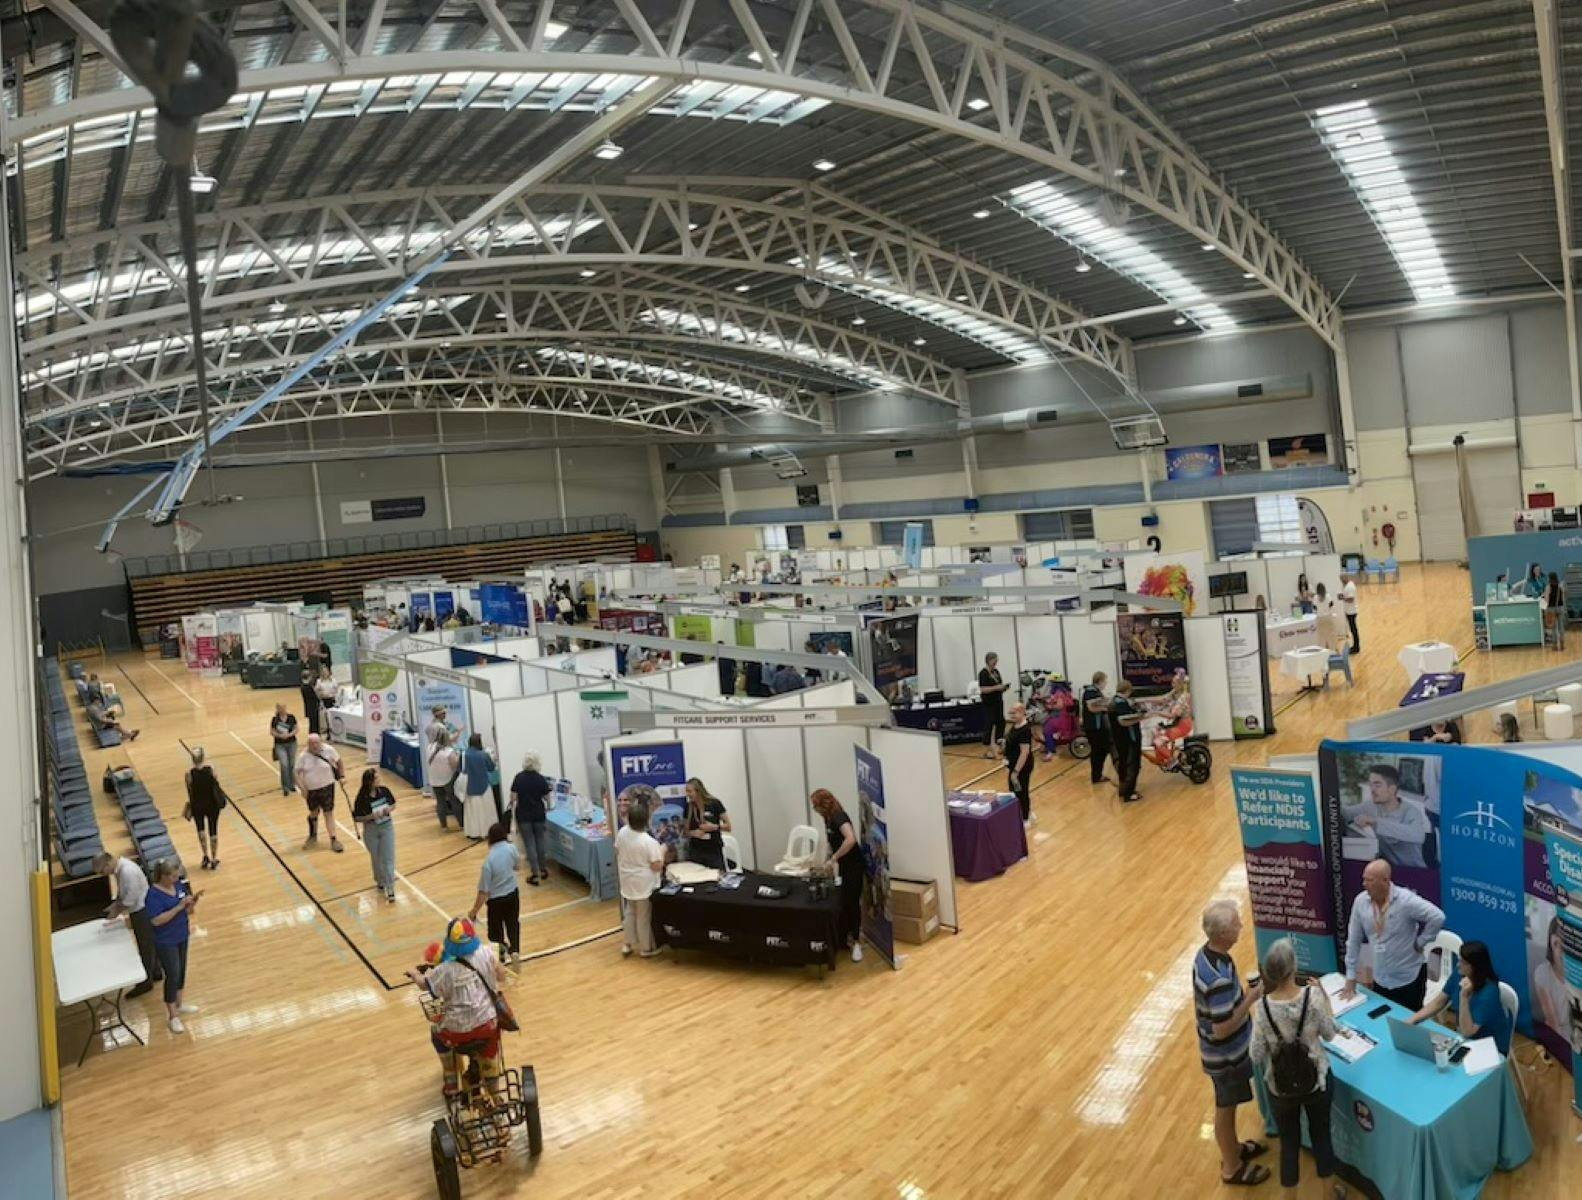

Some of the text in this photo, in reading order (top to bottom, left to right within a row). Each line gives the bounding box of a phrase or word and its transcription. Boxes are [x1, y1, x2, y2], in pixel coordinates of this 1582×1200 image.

[673, 715, 702, 724] FITCARE
[705, 715, 738, 724] SUPPORT
[740, 714, 776, 724] SERVICES
[1238, 787, 1306, 804] We'd like to
[1242, 800, 1305, 816] Refer NDIS
[1240, 812, 1312, 831] Participants
[1328, 795, 1342, 872] OPPORTUNITY
[1451, 824, 1516, 848] HORIZON
[1333, 873, 1344, 930] CHANGING
[1451, 888, 1517, 914] 1300 859 278
